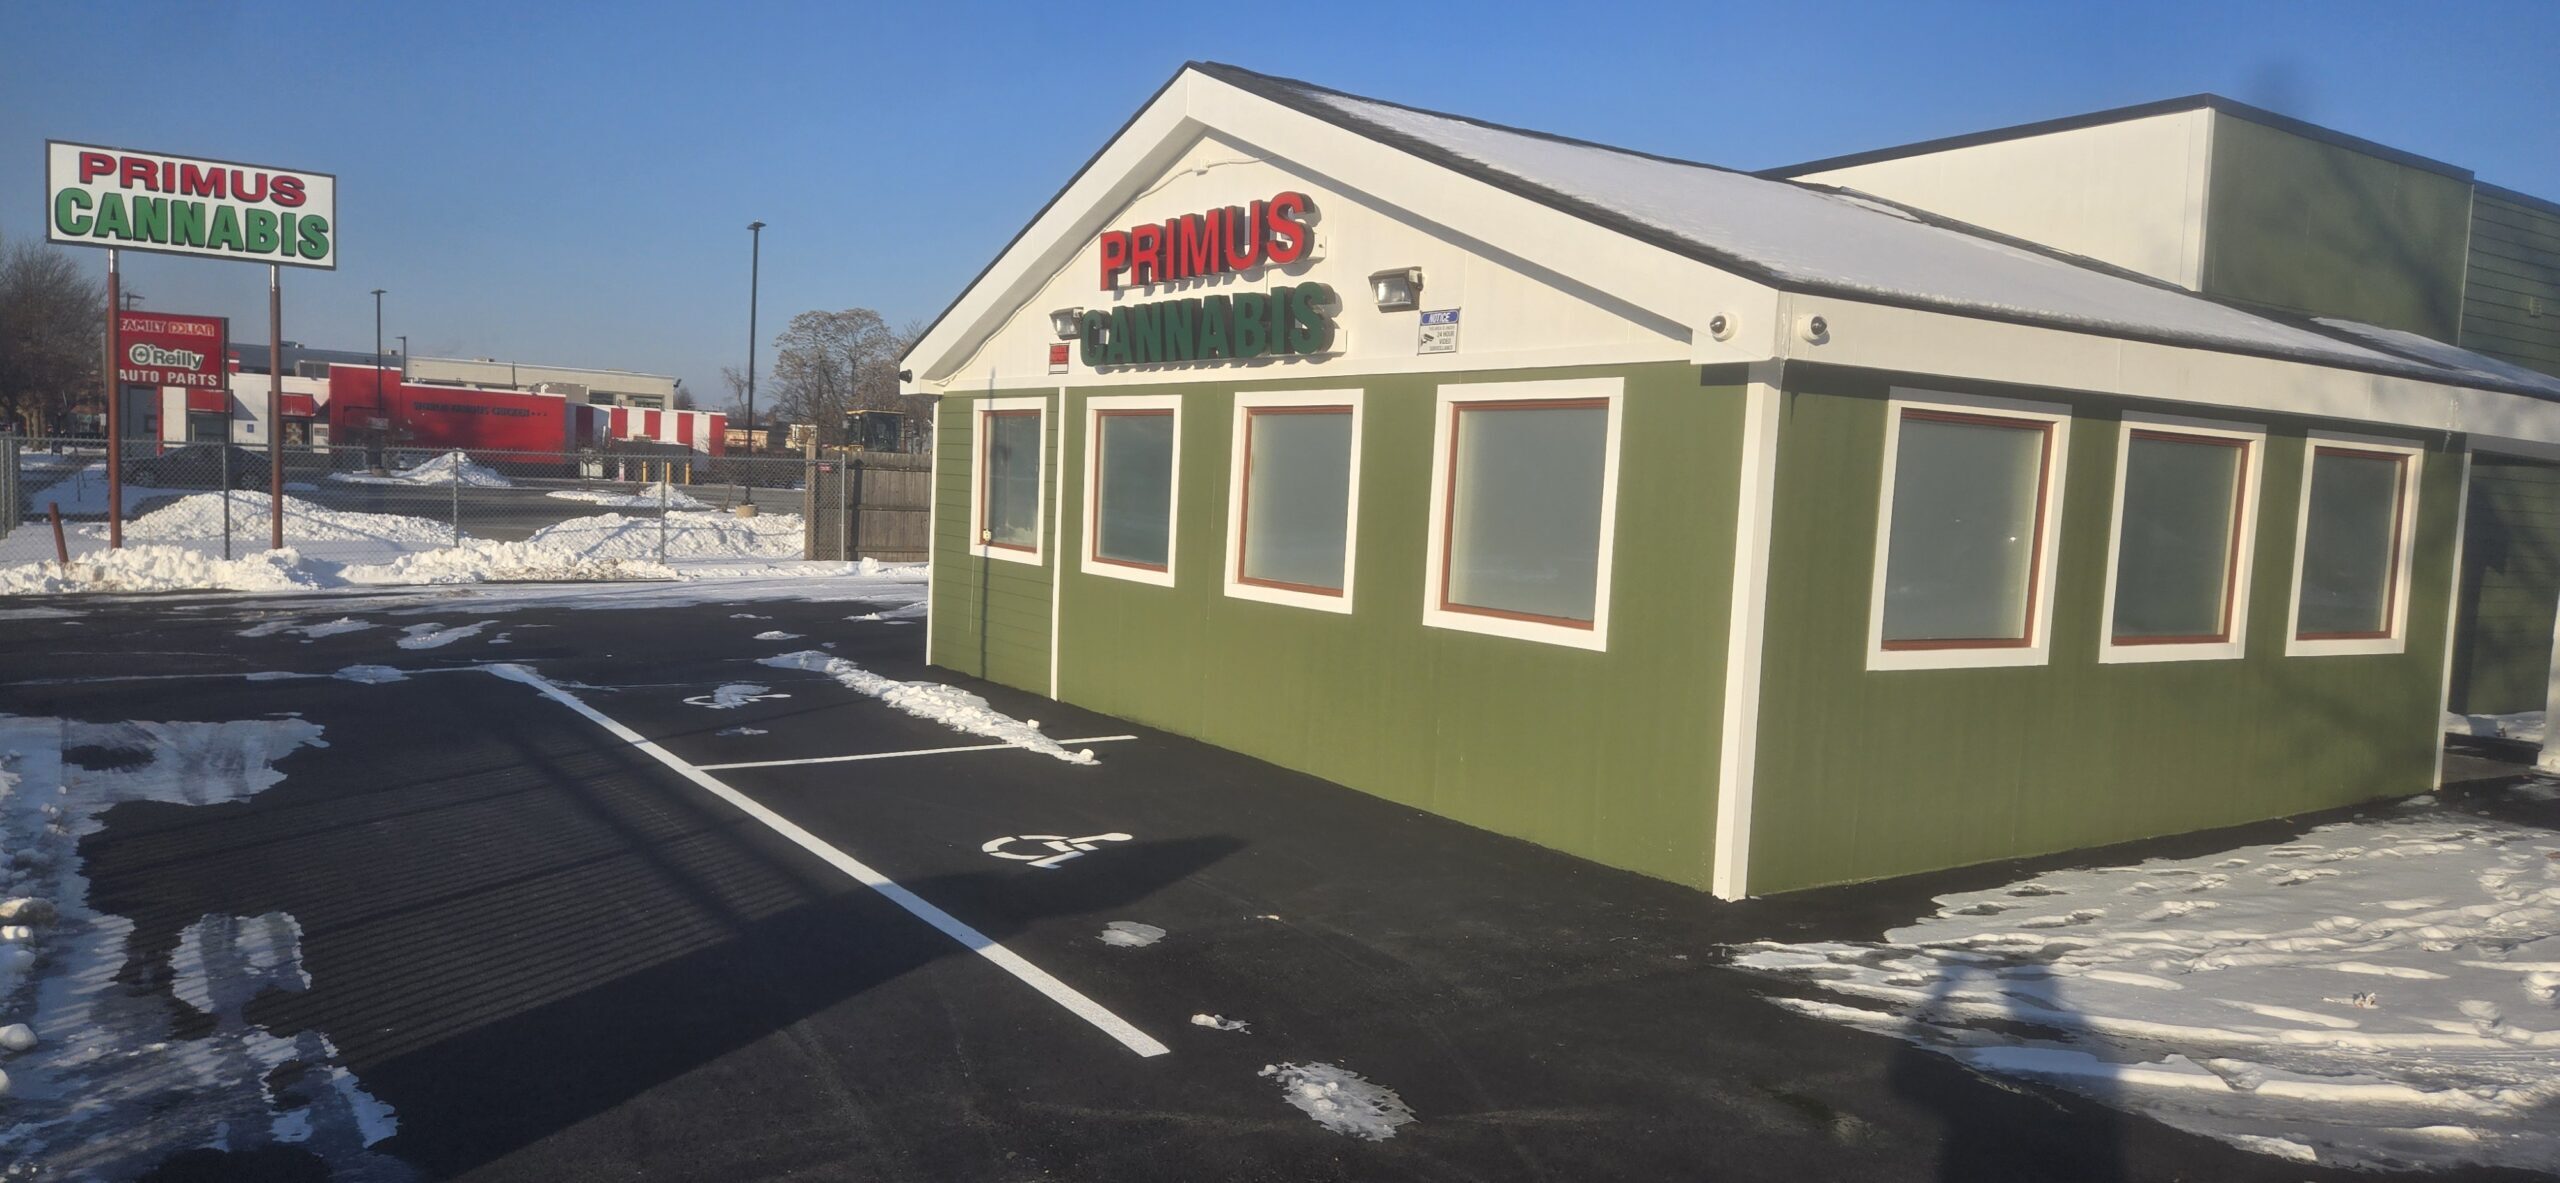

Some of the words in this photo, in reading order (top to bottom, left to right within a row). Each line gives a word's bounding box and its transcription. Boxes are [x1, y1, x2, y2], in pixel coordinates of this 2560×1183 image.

[79, 151, 307, 208] PRIMUS
[55, 187, 330, 260] CANNABIS
[1100, 191, 1309, 291] PRIMUS
[119, 319, 166, 333] FAMILY
[168, 321, 215, 336] DOLLAR
[1080, 281, 1330, 367] CANNABIS
[1429, 312, 1451, 322] NOTICE
[119, 369, 159, 382] AUTO
[167, 372, 217, 386] PARTS
[129, 343, 204, 370] O'Reilly
